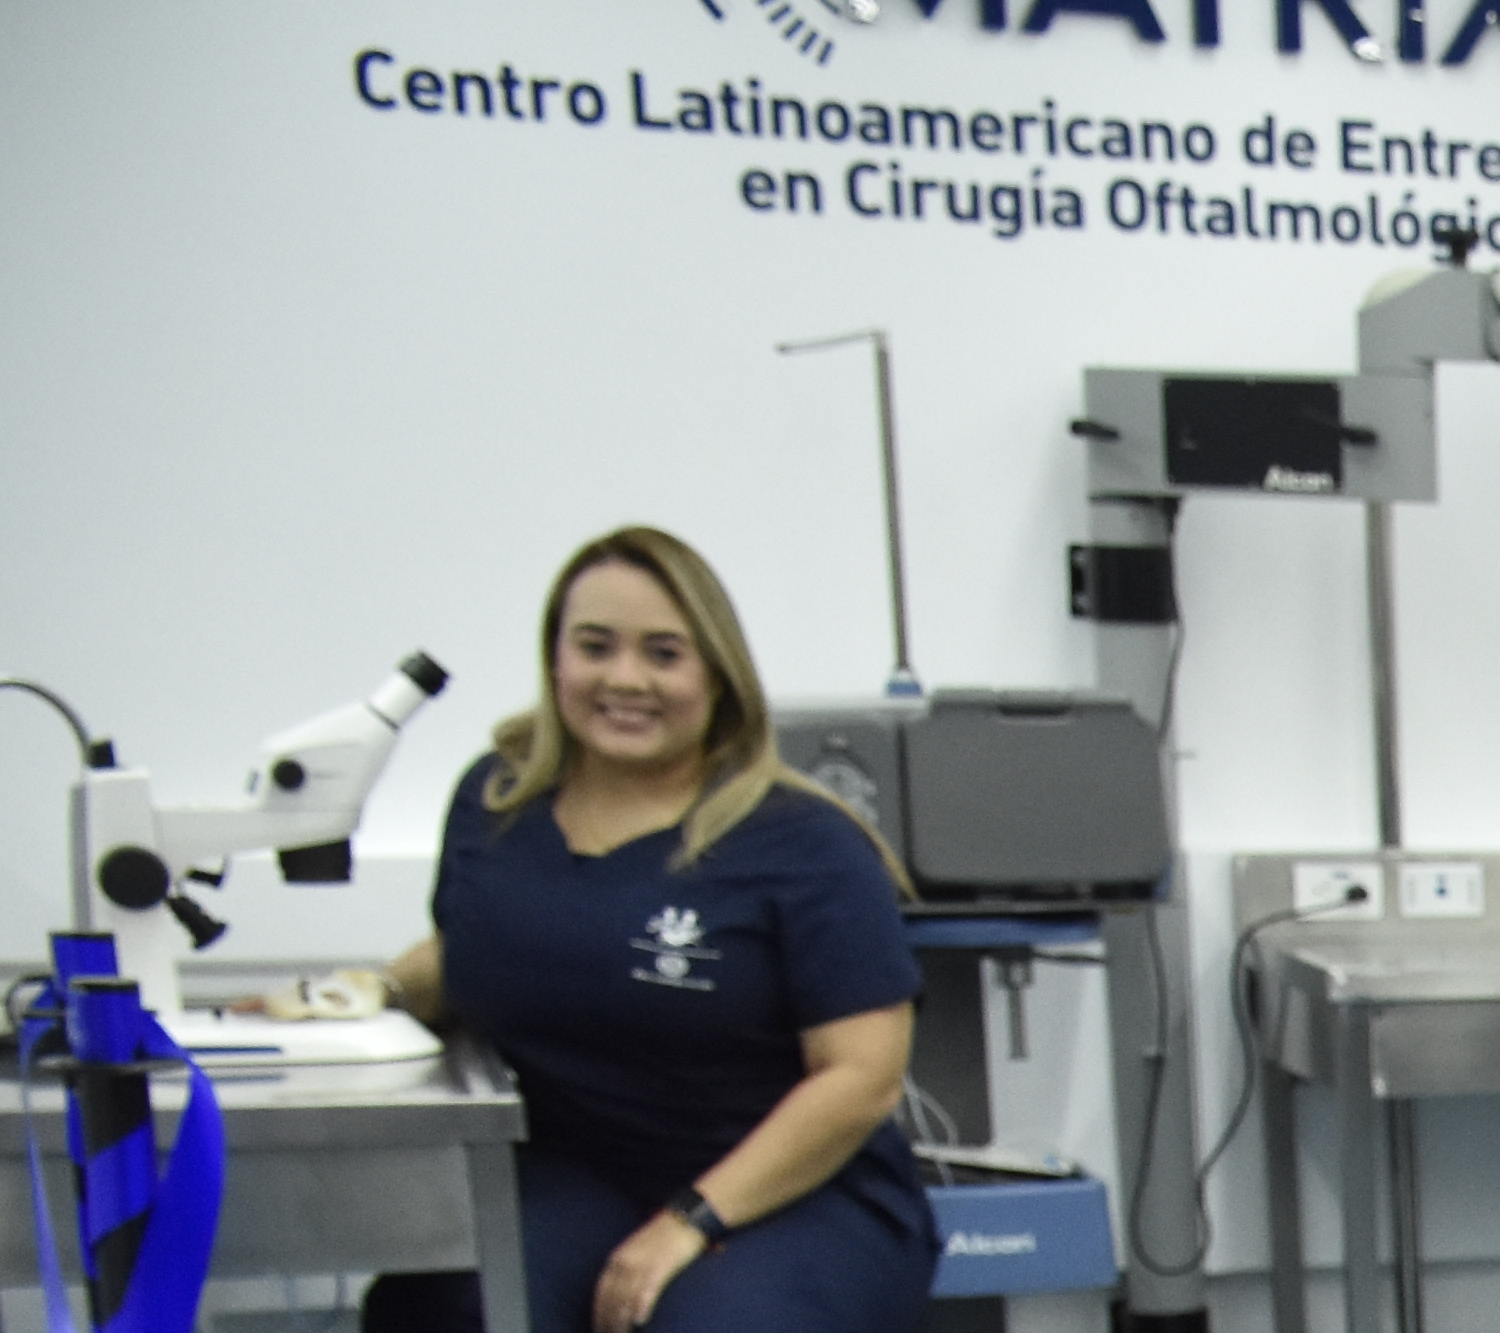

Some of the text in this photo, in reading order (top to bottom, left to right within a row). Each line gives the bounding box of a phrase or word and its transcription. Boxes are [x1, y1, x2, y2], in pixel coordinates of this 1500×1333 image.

[354, 49, 607, 126] Centro
[629, 71, 1217, 162] Latinoamericano
[1243, 115, 1316, 169] de
[739, 168, 823, 213] en
[845, 162, 1083, 240] Cirugía
[945, 1231, 1037, 1258] Alcon
